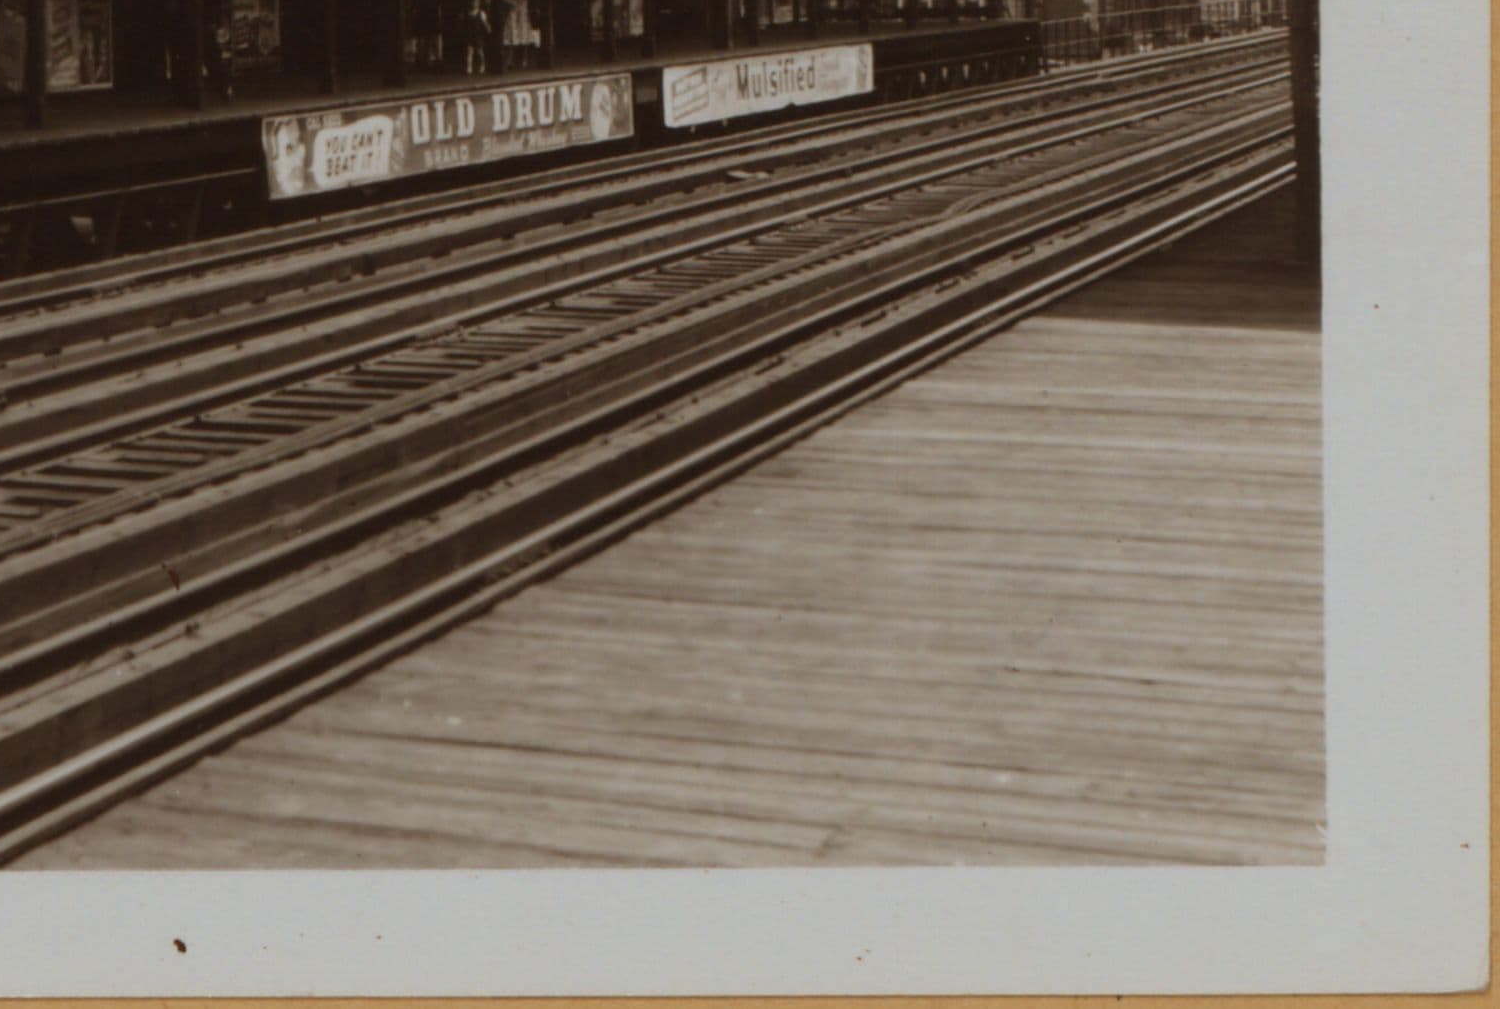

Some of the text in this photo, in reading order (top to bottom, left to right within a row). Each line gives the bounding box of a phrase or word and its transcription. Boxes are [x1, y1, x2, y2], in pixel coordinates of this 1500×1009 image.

[736, 55, 816, 100] Mulsified
[411, 83, 583, 144] OLD DRUM
[325, 134, 348, 155] YOU
[424, 142, 469, 170] BRAND
[325, 150, 357, 177] BEAT
